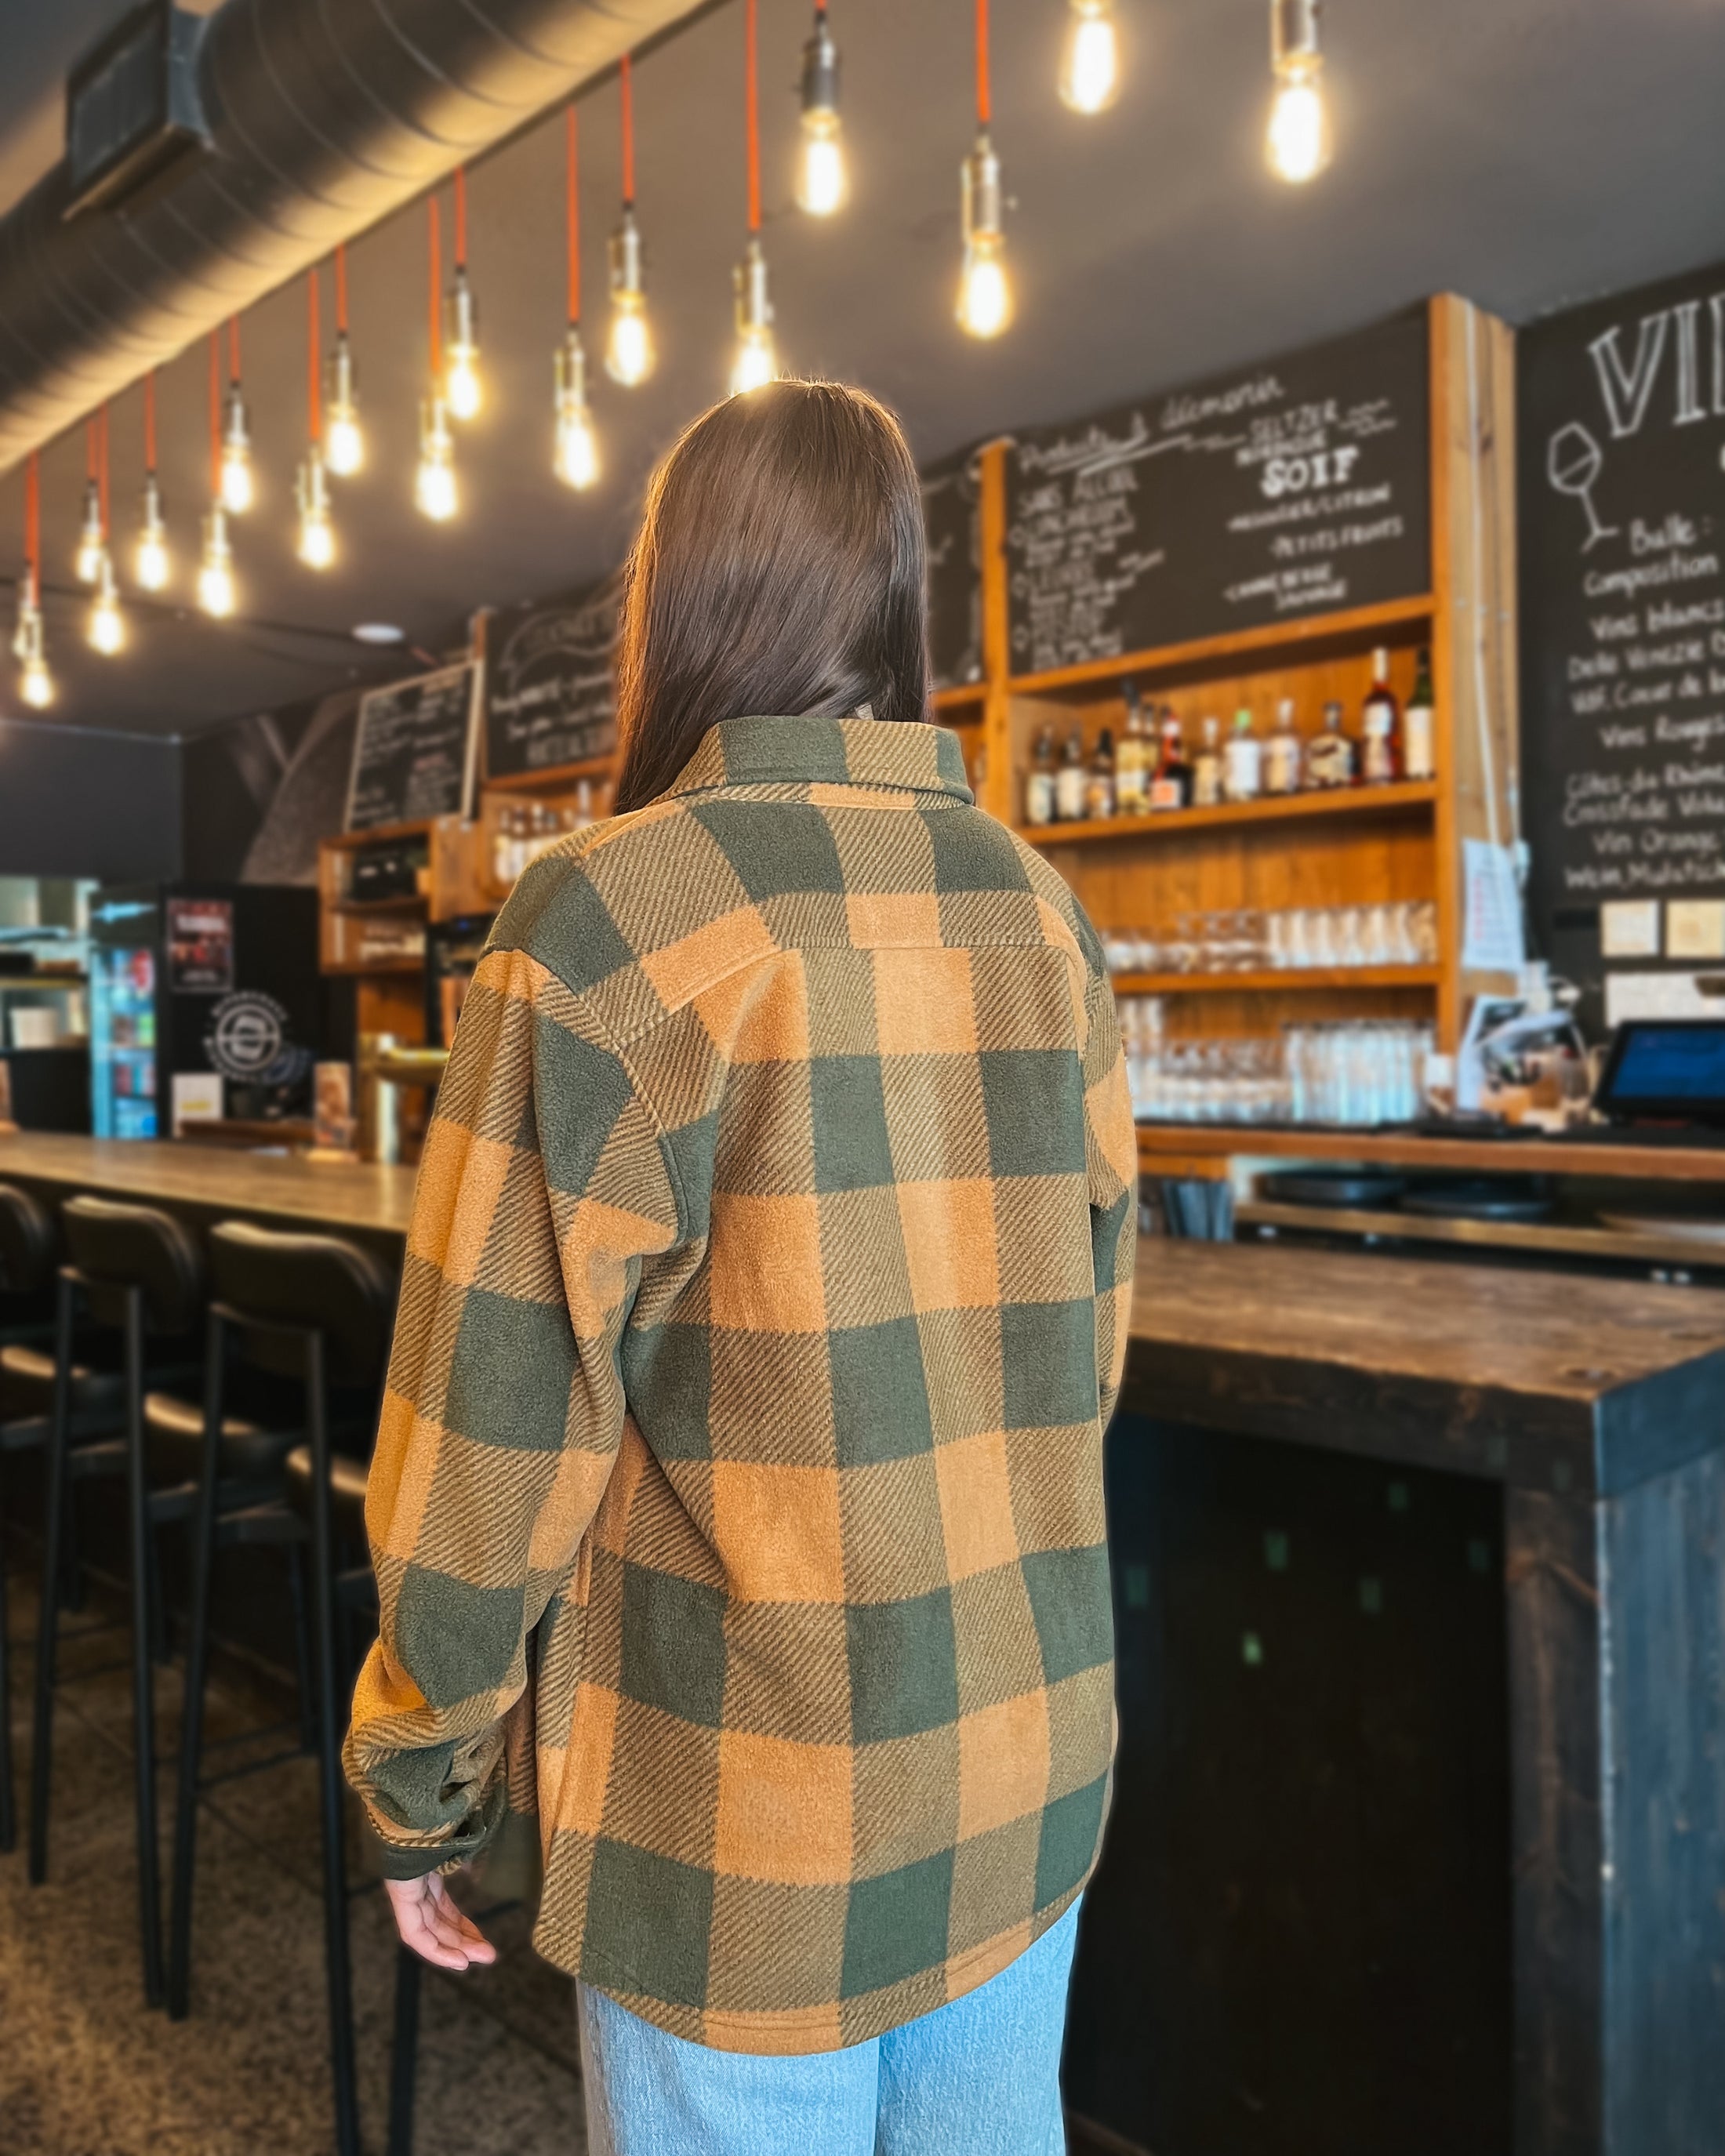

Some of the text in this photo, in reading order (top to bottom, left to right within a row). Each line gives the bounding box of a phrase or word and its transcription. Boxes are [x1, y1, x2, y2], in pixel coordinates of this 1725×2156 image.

[1260, 446, 1360, 498] SOIF
[1584, 550, 1720, 599] Composition
[1590, 614, 1638, 640] Vins
[1600, 725, 1646, 748] Vins
[1592, 830, 1633, 854] Vin
